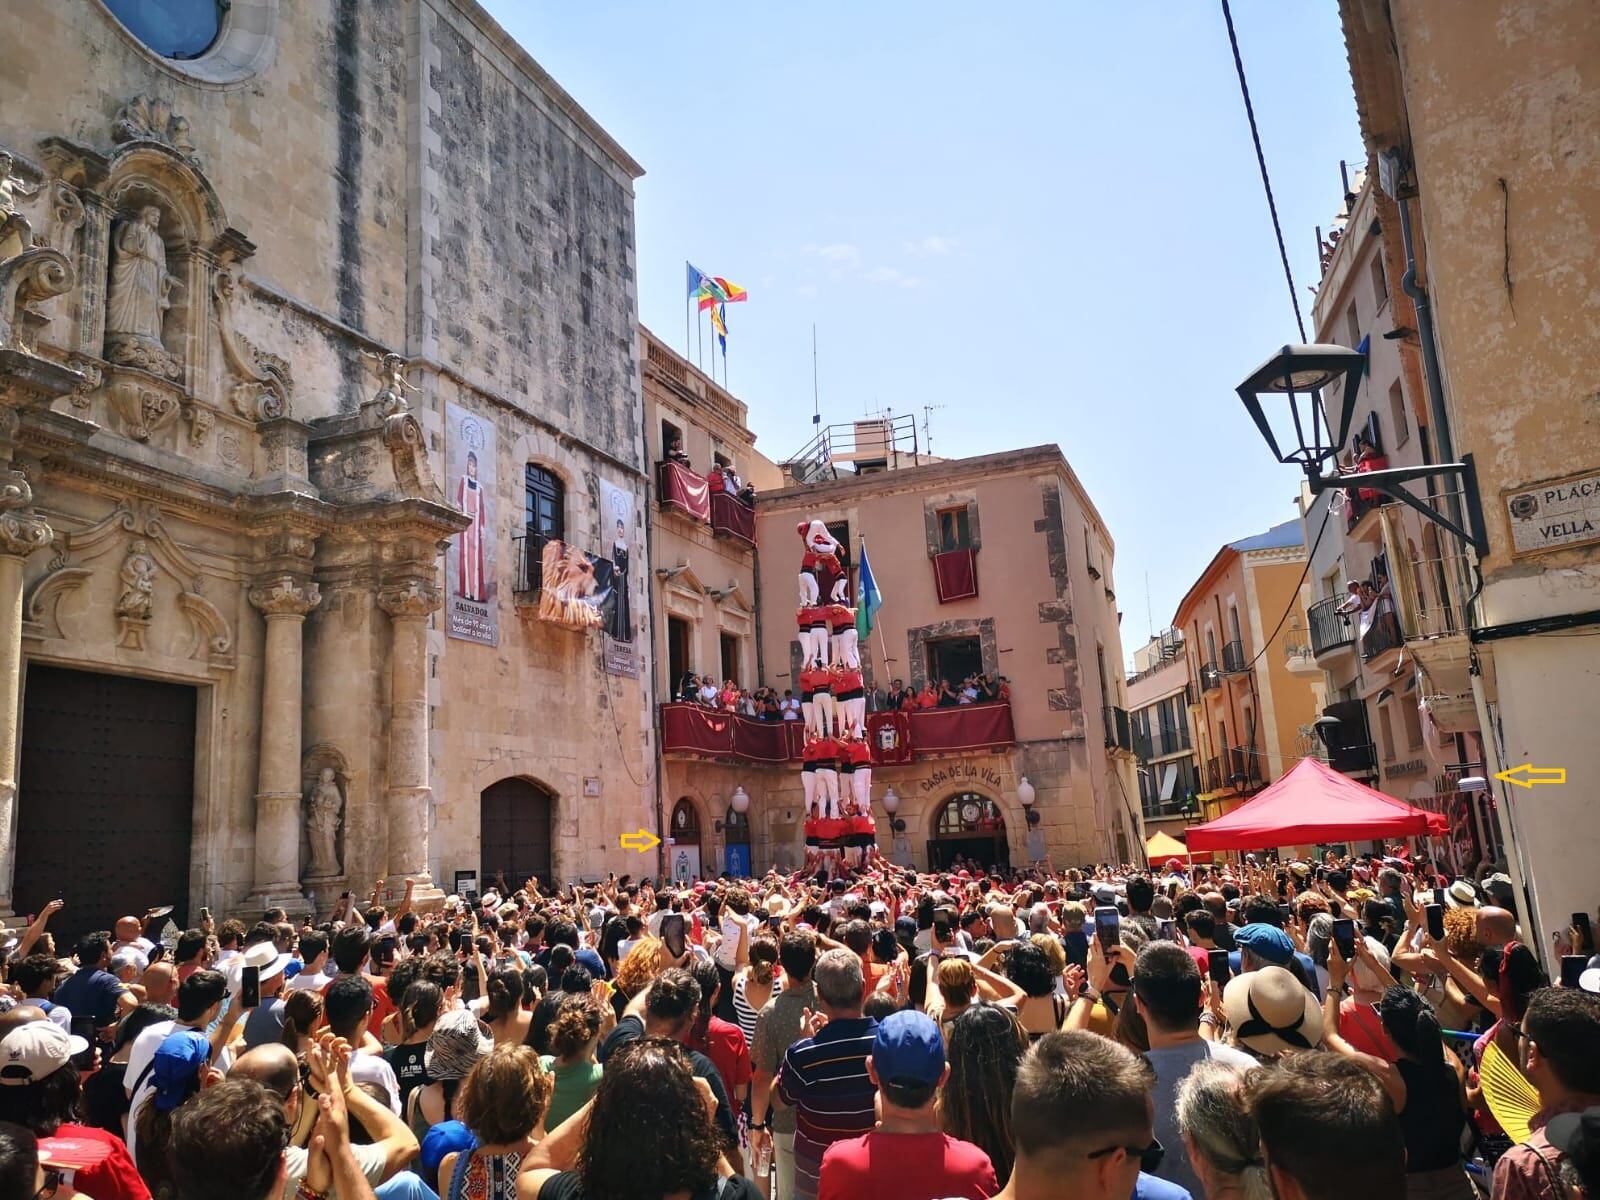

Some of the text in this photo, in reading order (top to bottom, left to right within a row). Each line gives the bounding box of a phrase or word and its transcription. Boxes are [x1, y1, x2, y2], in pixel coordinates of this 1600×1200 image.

[1545, 481, 1600, 504] PLAÇA
[1539, 520, 1594, 539] VELLA
[455, 601, 488, 617] SALVADOR
[921, 770, 948, 792] CASA
[948, 766, 961, 778] DE
[964, 765, 977, 777] LA
[400, 1065, 409, 1073] LA
